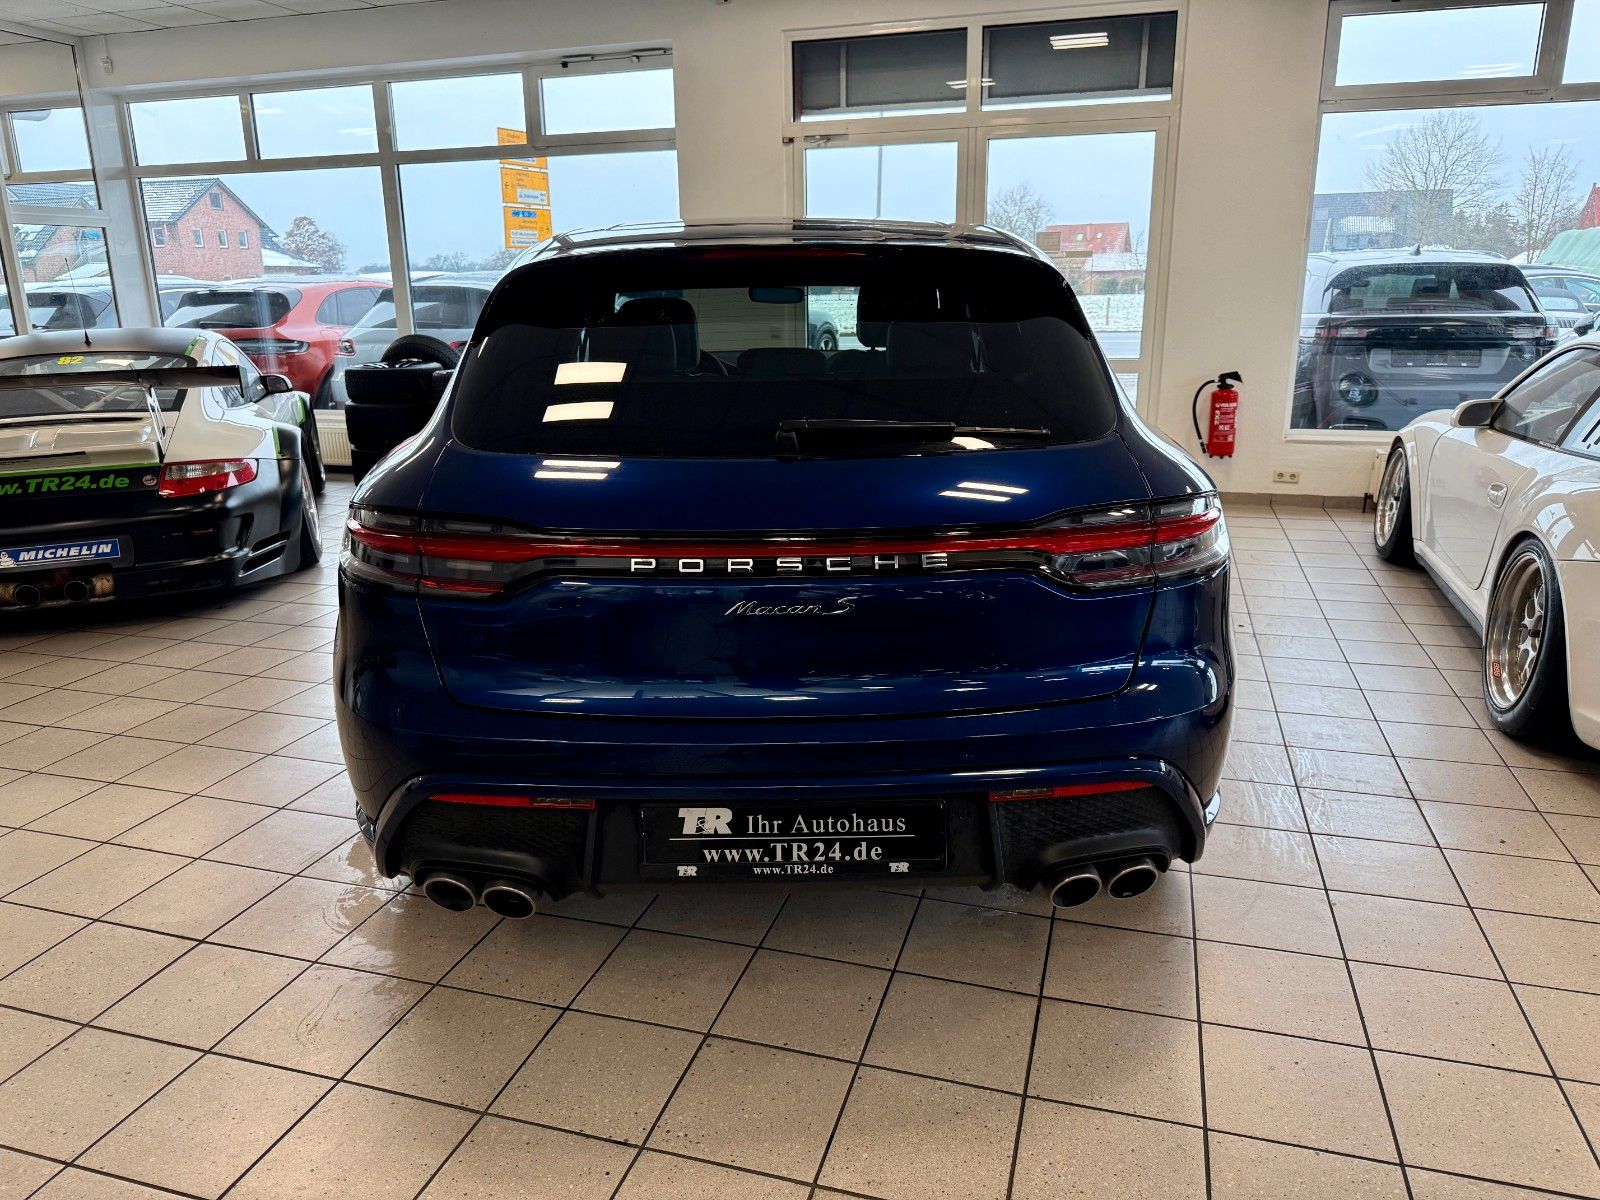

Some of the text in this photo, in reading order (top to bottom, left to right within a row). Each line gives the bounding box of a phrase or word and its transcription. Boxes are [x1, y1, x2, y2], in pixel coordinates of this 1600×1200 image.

[19, 544, 112, 561] MICHELIN
[630, 553, 947, 572] PORSCHE
[724, 597, 856, 616] Macan S
[747, 815, 782, 834] Ihr
[791, 813, 906, 833] Autohaus
[703, 842, 883, 862] www.TR24.de
[753, 864, 834, 875] www.TR24.de
